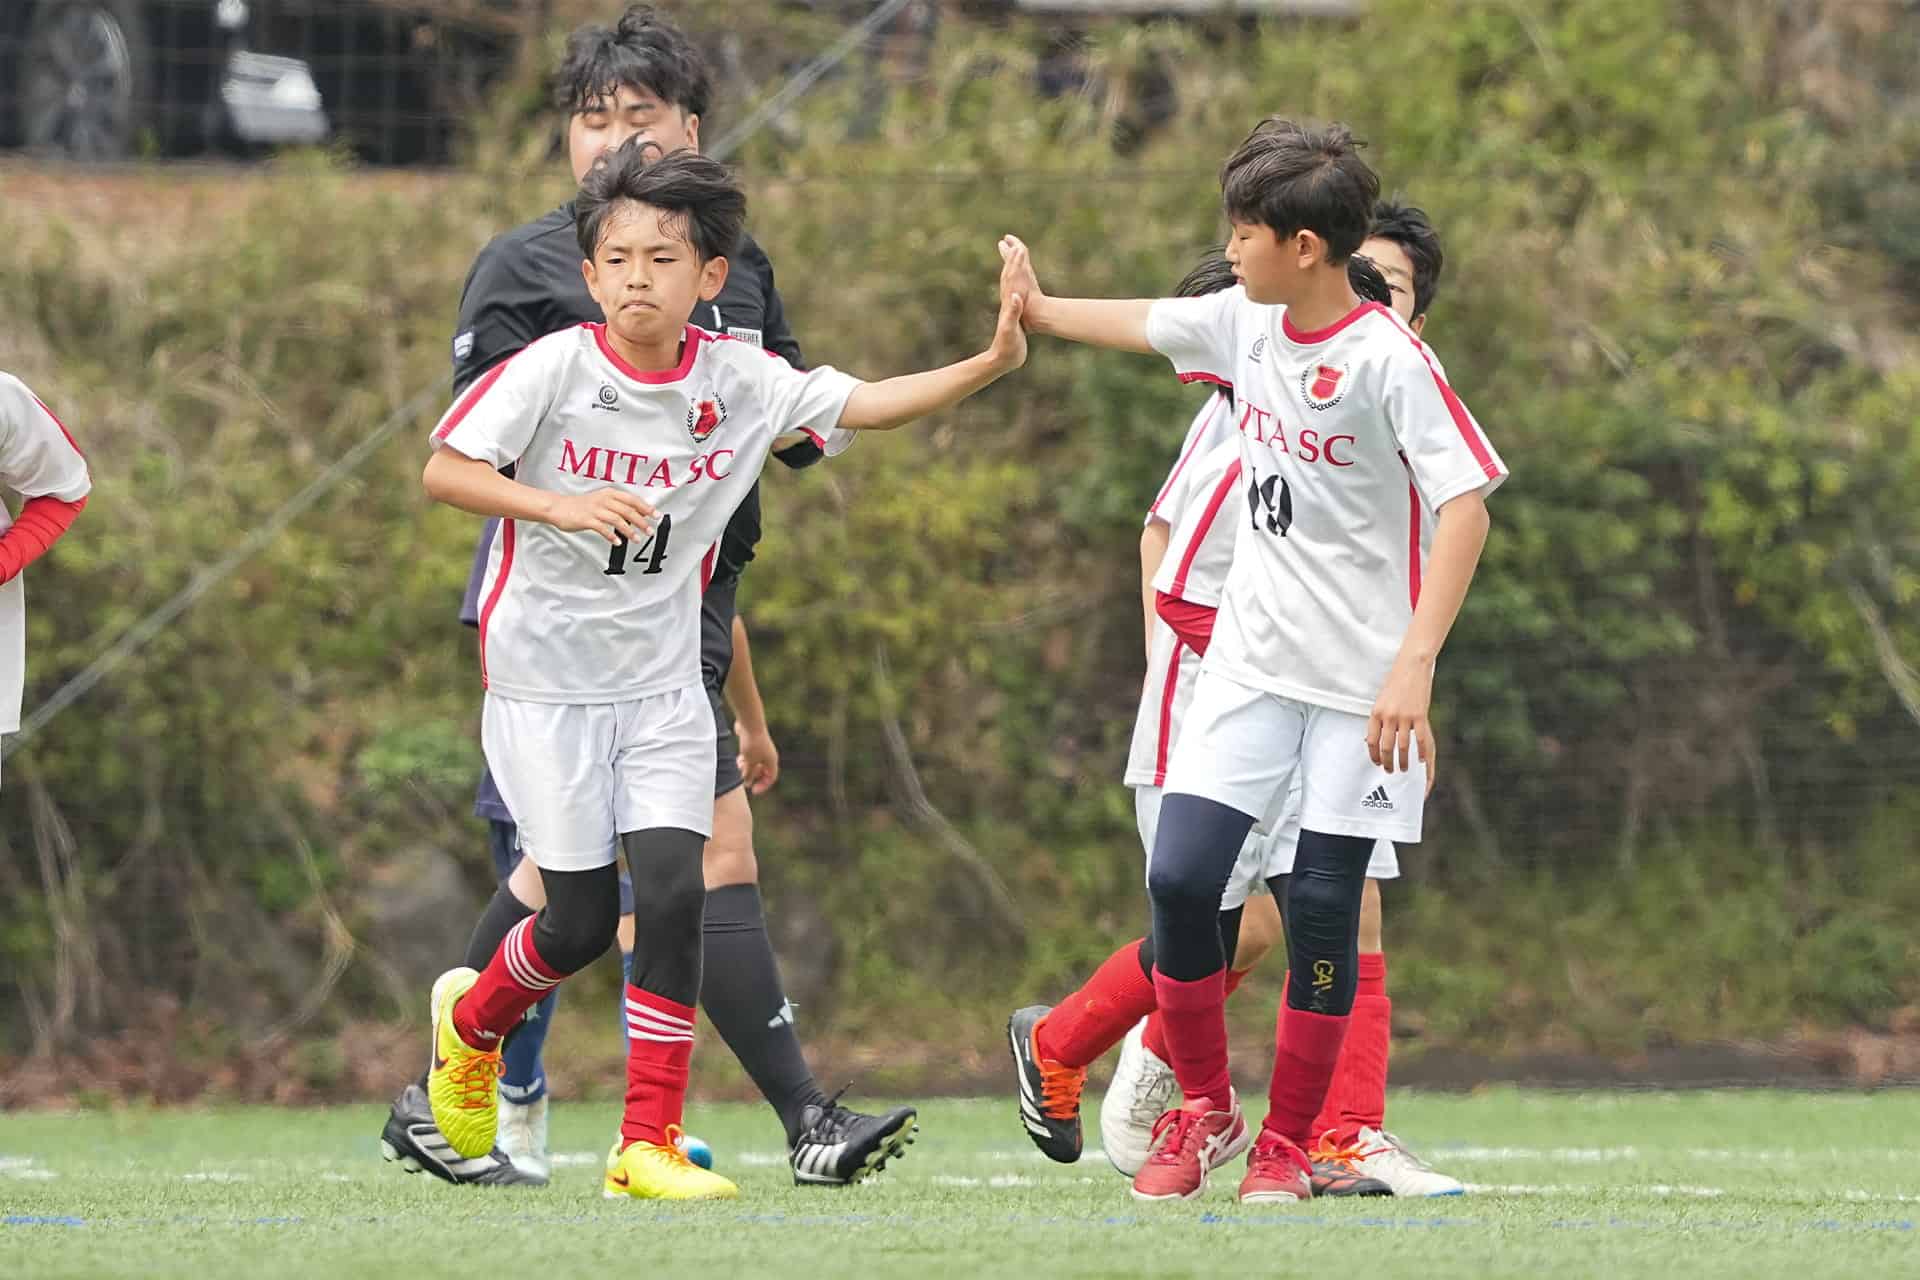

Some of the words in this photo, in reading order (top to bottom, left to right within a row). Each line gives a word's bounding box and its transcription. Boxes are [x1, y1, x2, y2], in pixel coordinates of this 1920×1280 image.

[1238, 398, 1289, 454] ITA
[1298, 429, 1356, 467] SC
[557, 438, 676, 489] MITA
[687, 449, 734, 484] SC
[603, 514, 671, 575] 14
[1361, 800, 1393, 810] adidas
